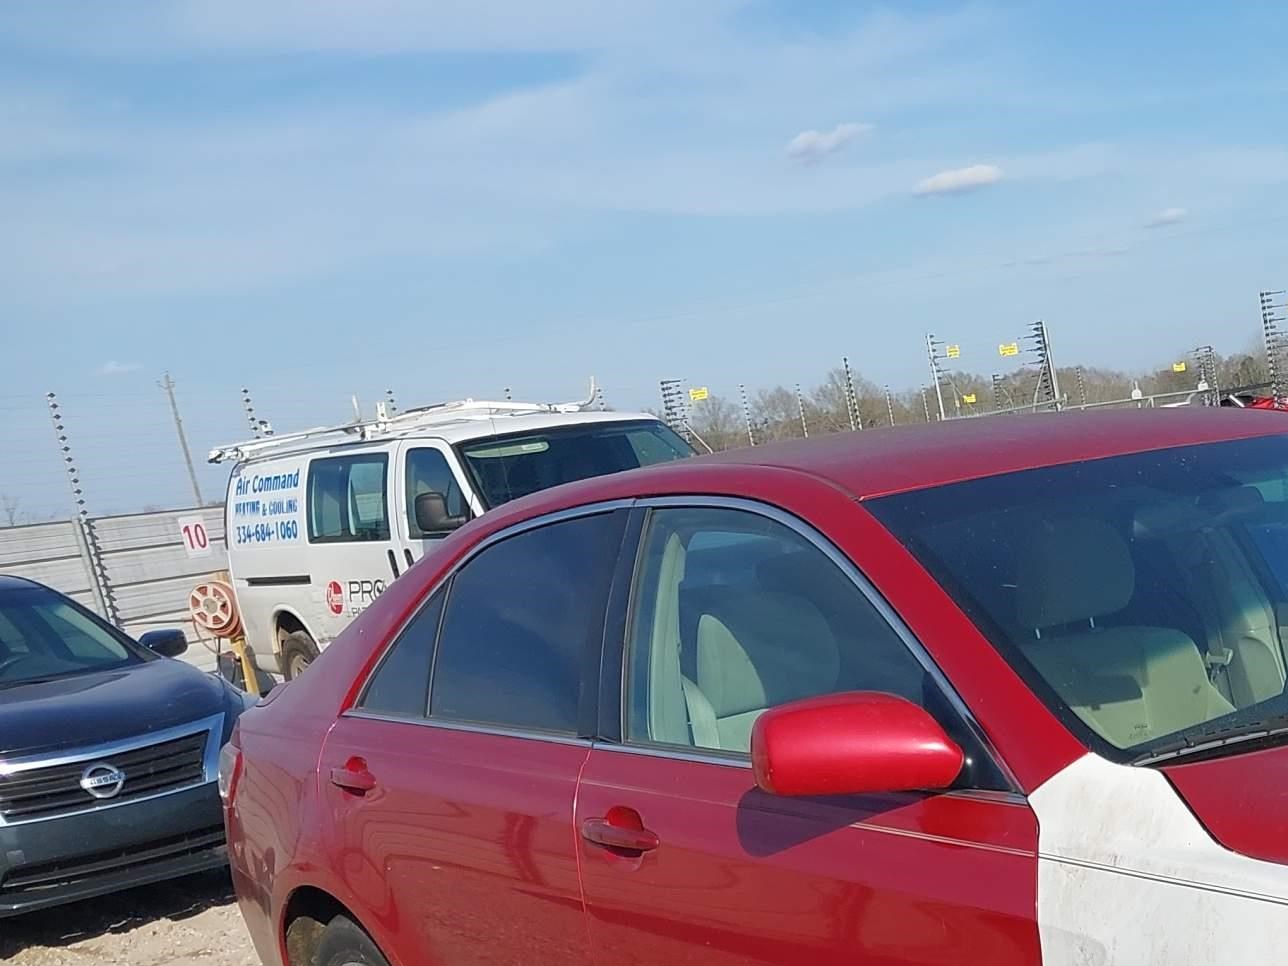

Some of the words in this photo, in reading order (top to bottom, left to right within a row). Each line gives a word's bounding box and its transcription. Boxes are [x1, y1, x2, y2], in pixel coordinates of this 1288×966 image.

[236, 476, 250, 495] Air
[252, 468, 300, 493] Command
[262, 503, 267, 516] &
[269, 499, 298, 515] COOLING
[183, 523, 207, 549] 10
[236, 520, 298, 544] 334-684-1060
